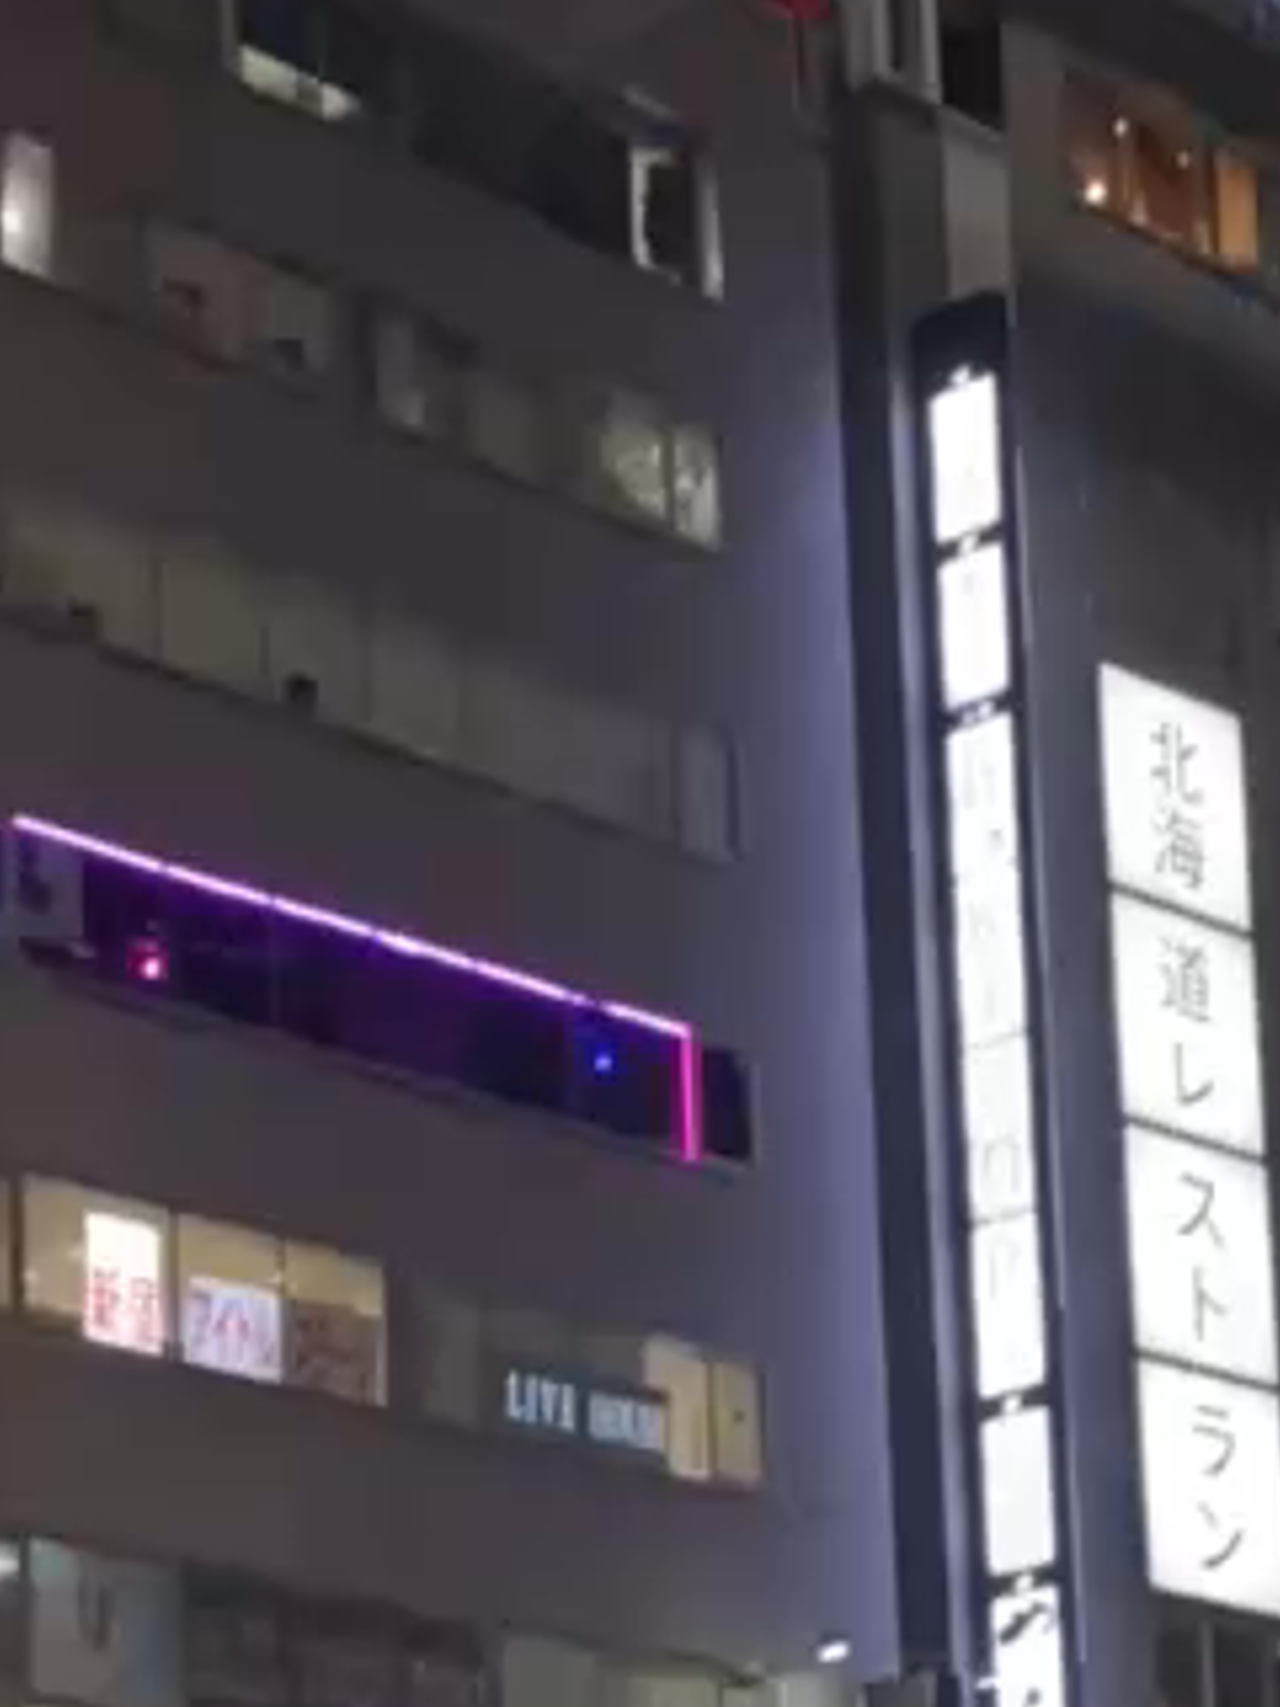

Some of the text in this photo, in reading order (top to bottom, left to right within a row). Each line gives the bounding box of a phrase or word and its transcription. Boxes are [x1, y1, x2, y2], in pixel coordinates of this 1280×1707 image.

[1150, 719, 1246, 1570] 北海道レストラン
[505, 1368, 577, 1433] LIVE
